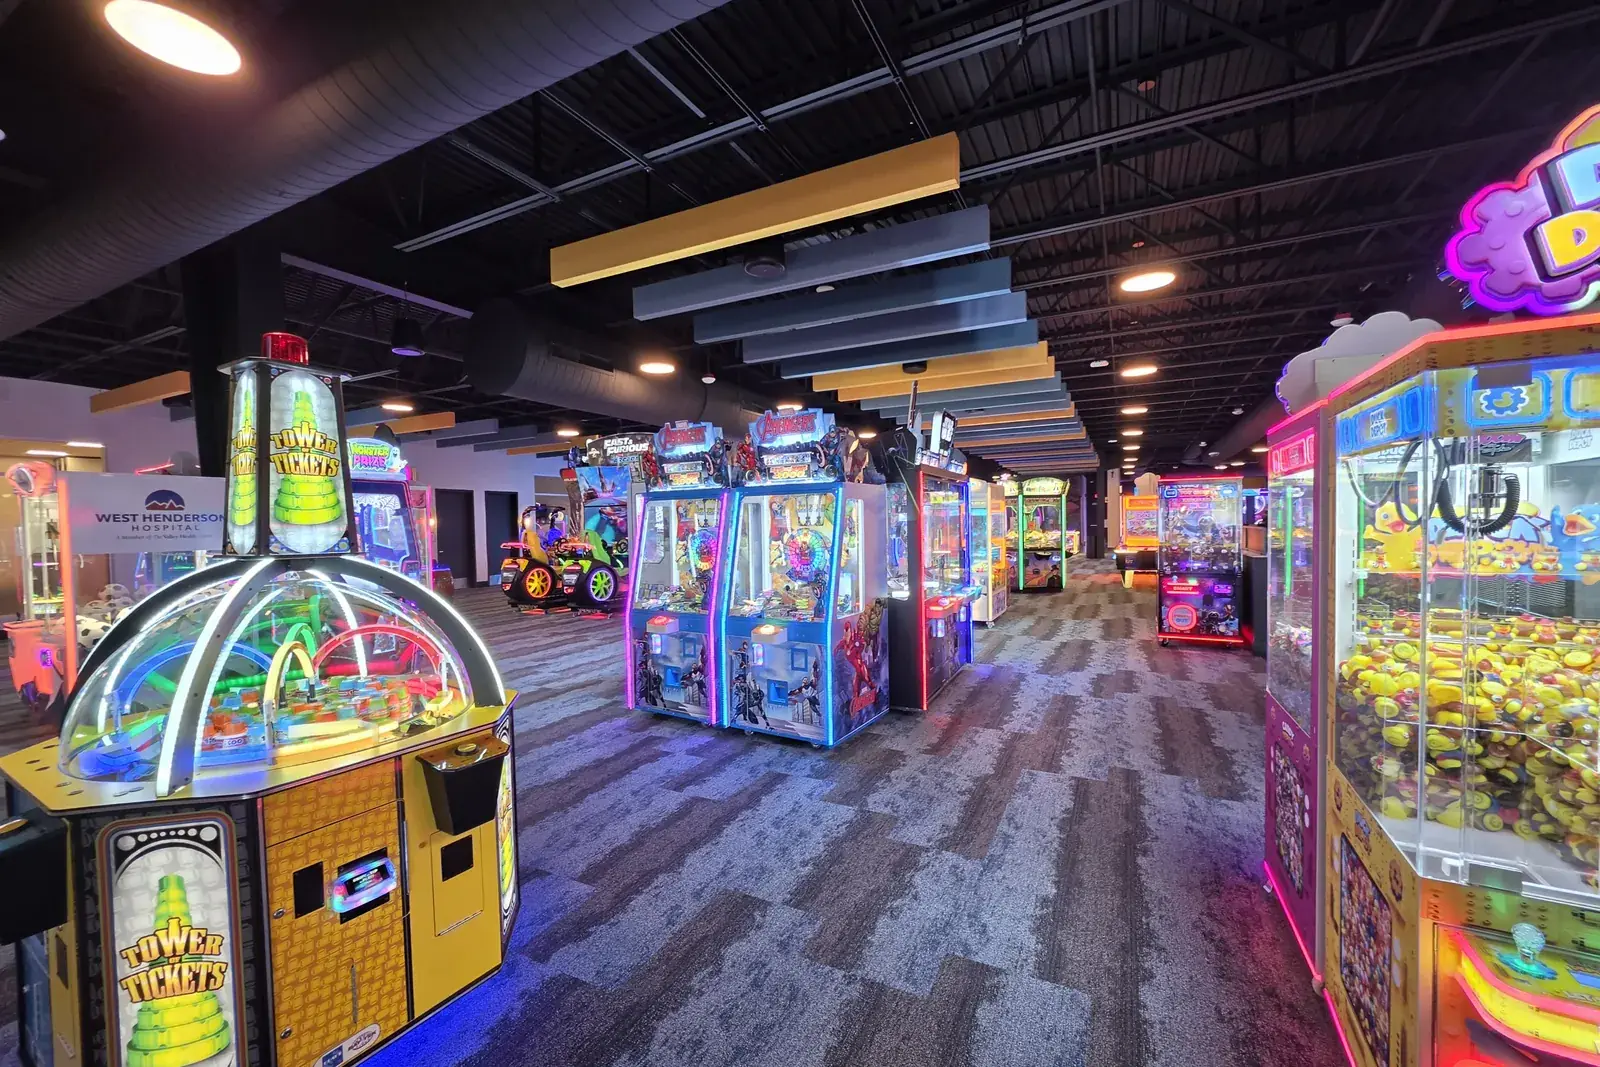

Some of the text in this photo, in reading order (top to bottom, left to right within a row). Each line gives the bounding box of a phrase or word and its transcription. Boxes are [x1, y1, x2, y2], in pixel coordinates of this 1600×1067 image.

[270, 420, 338, 454] TOWER
[604, 437, 629, 450] FAST
[606, 442, 650, 457] FURIOUS
[270, 452, 340, 477] TICKETS
[354, 455, 387, 468] PRIZE
[95, 513, 139, 523] WEST
[131, 524, 200, 532] HOSPITAL
[119, 917, 225, 968] TOWER
[119, 961, 228, 1003] TICKETS
